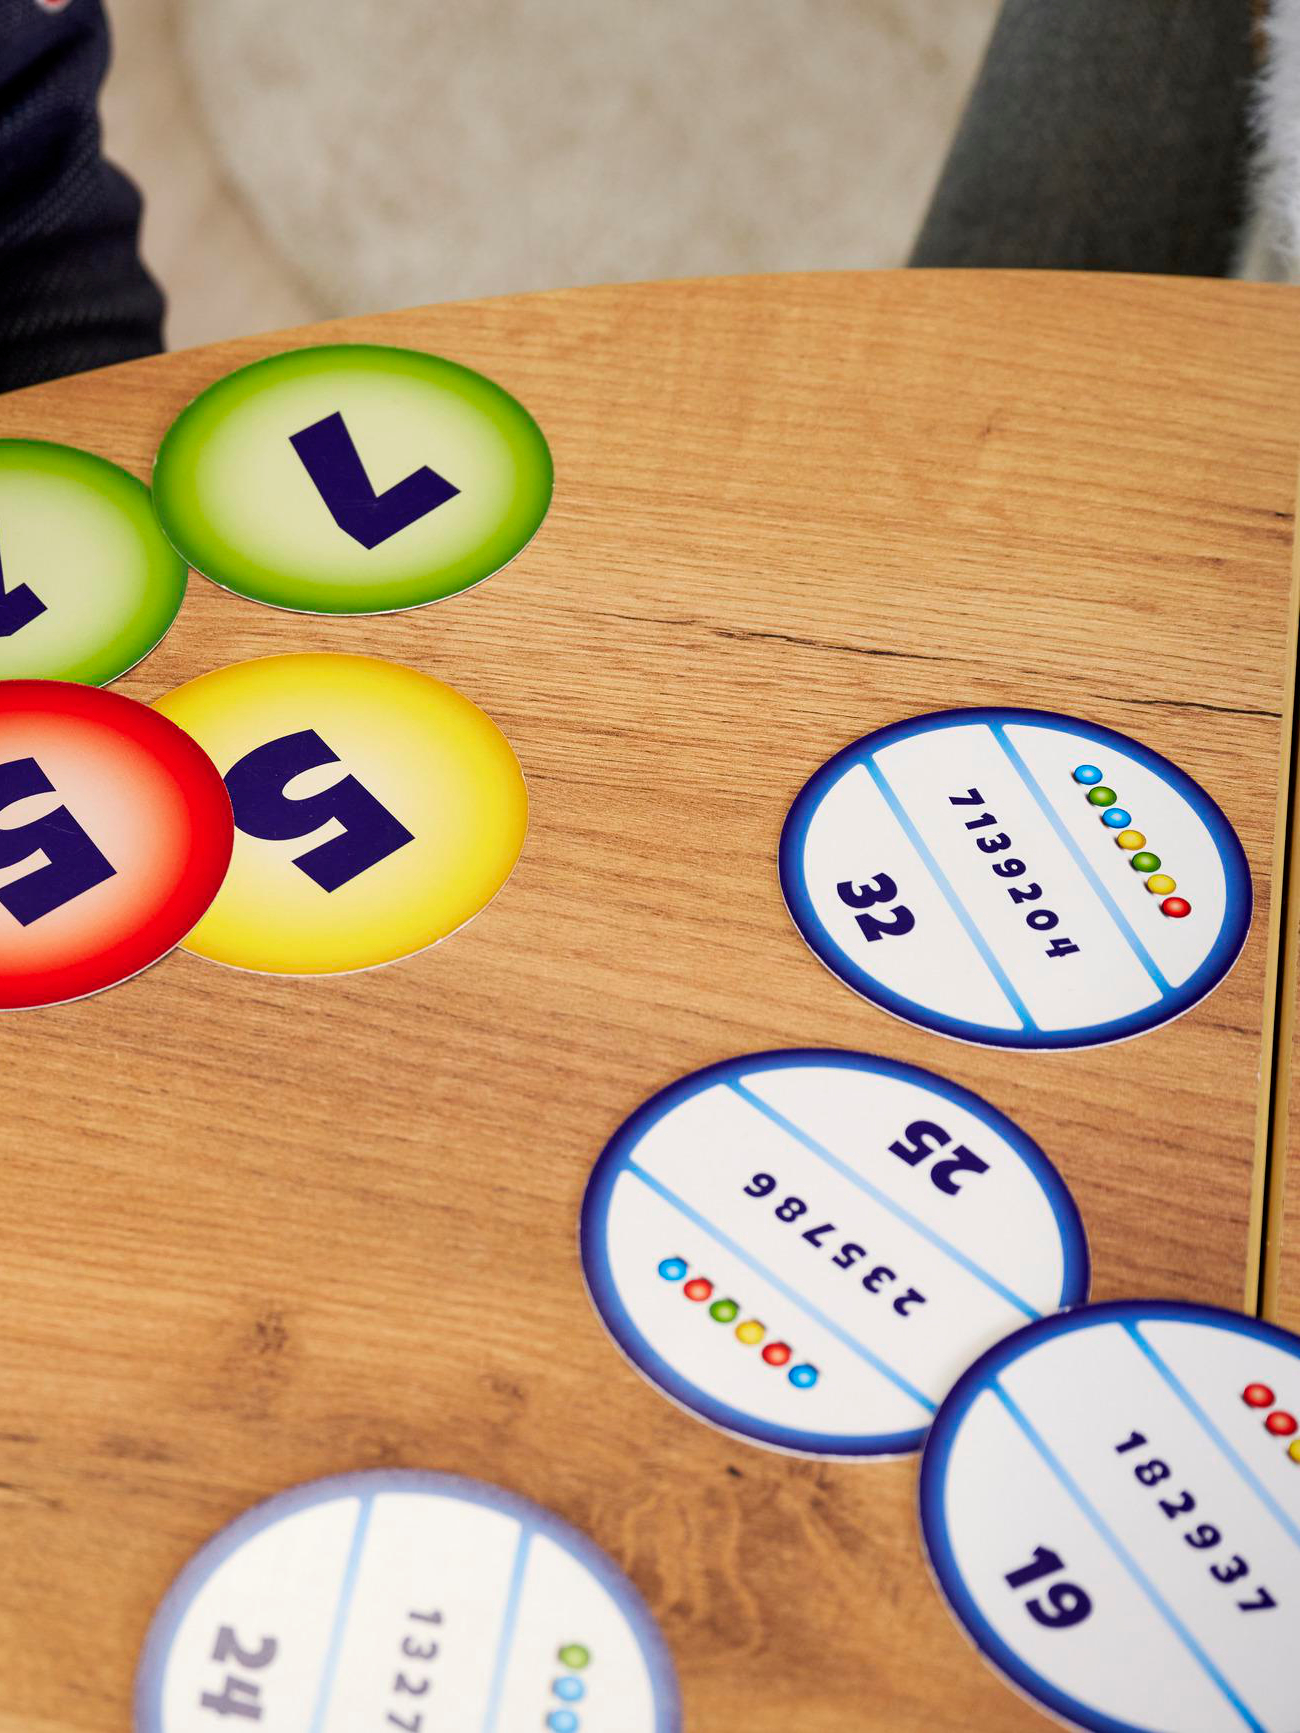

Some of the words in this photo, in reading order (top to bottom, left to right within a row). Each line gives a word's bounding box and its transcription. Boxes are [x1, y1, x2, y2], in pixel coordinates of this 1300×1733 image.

[289, 411, 461, 549] 7
[224, 729, 416, 893] 5
[836, 872, 916, 943] 32
[887, 1120, 991, 1196] 25
[1004, 1545, 1093, 1629] 19
[200, 1625, 278, 1721] 24
